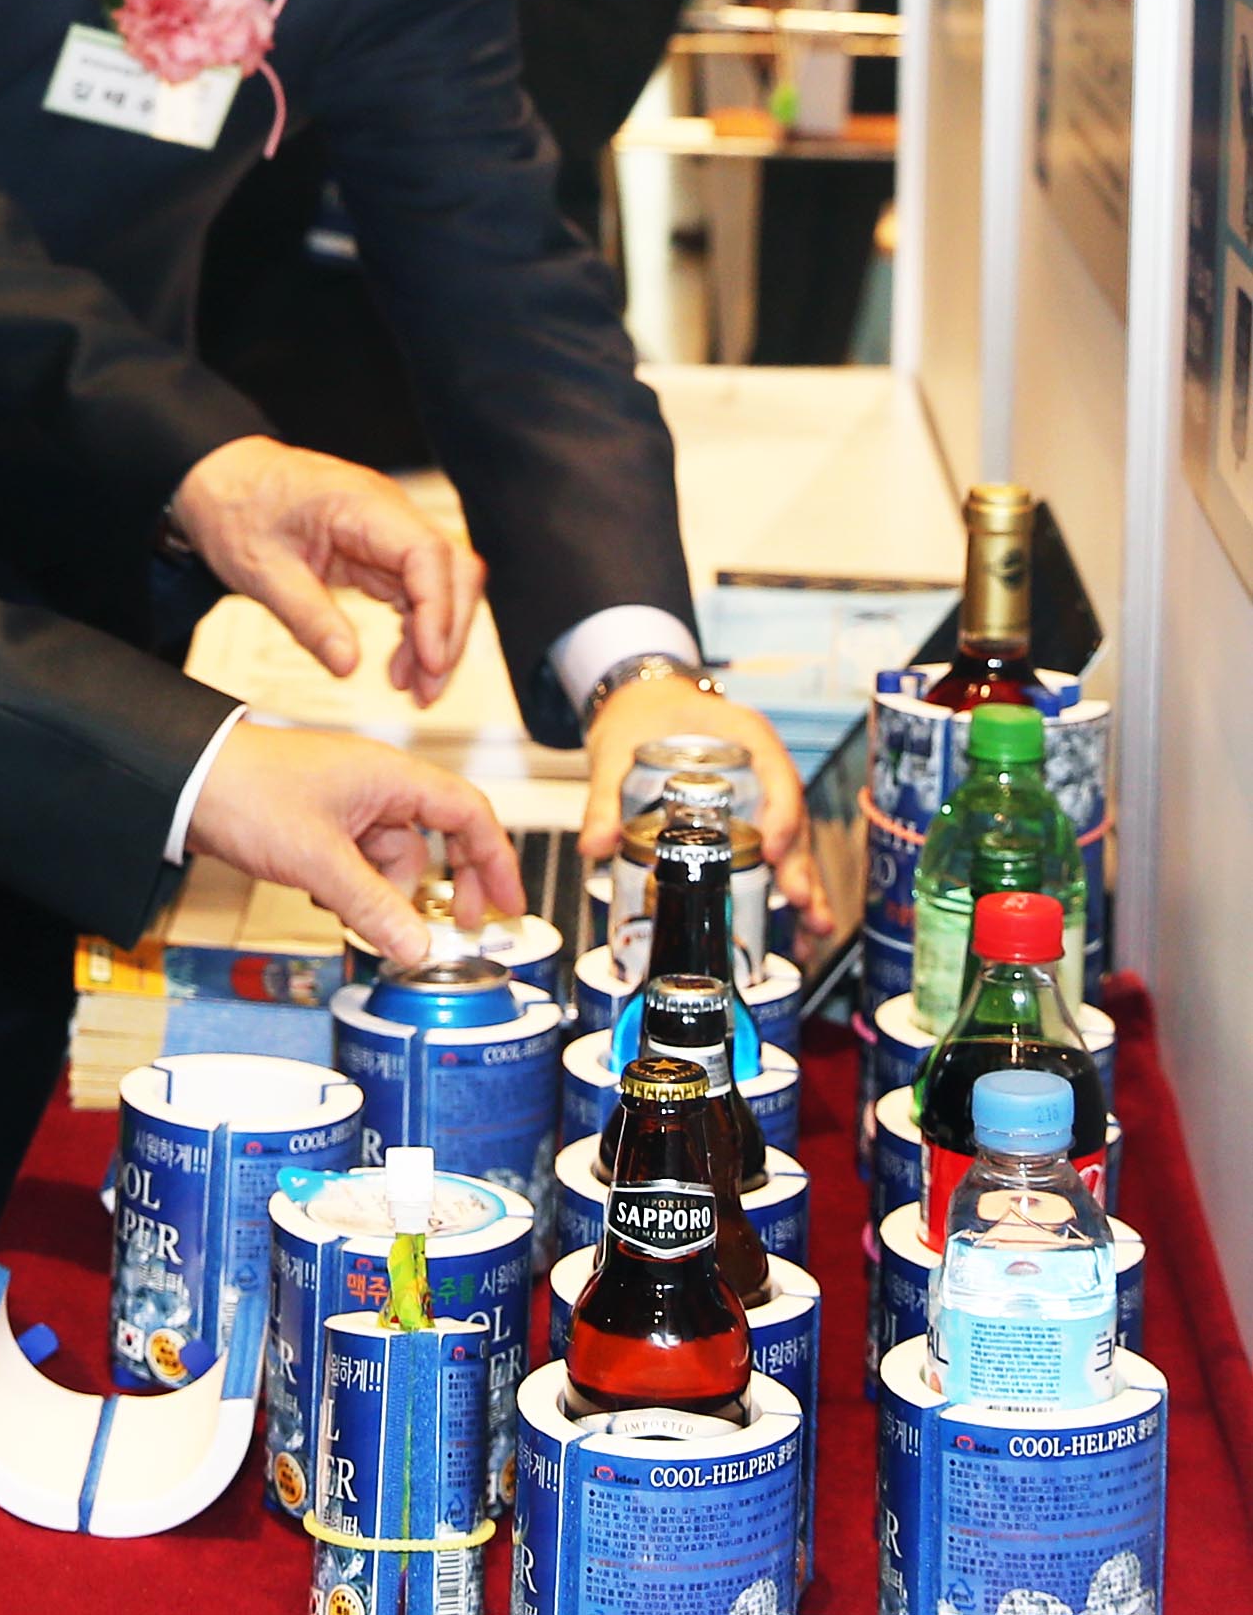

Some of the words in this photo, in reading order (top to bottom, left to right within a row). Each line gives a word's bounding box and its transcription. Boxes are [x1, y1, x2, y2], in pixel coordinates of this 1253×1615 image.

[616, 1201, 712, 1232] SAPPORO
[624, 1419, 695, 1435] IMPORTED
[1009, 1424, 1137, 1458] COOL-HELPER
[649, 1452, 777, 1488] COOL-HELPER
